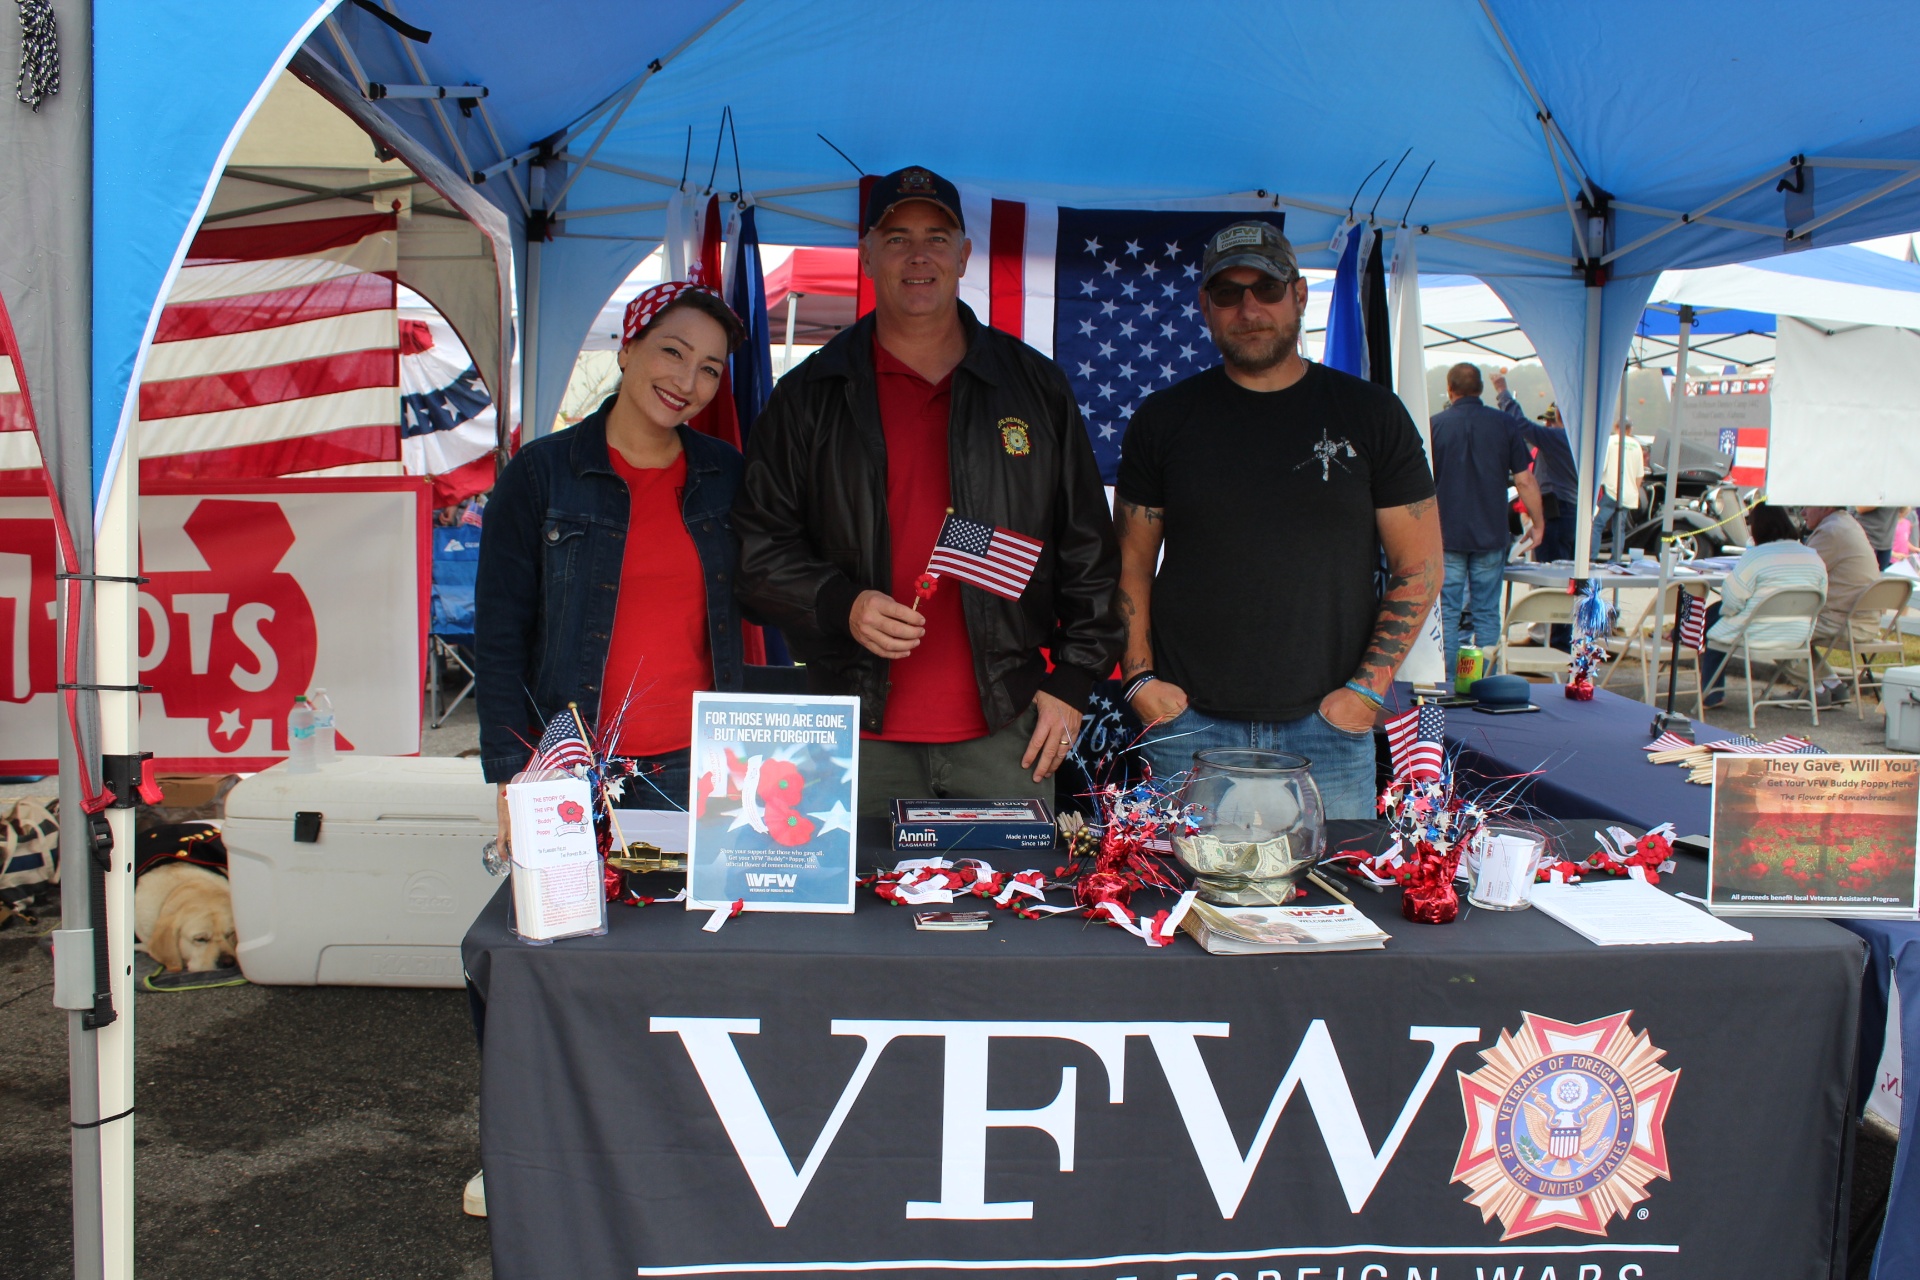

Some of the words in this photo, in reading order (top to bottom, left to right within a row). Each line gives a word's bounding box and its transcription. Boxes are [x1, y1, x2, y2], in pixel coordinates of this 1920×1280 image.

[705, 711, 727, 725] FOR
[728, 711, 763, 726] THOSE
[764, 713, 791, 727] WHO
[792, 714, 813, 727] ARE
[815, 714, 847, 730] GONE,
[714, 727, 735, 742] BUT
[737, 728, 771, 743] NEVER
[773, 729, 838, 744] FORGOTTEN.
[1764, 759, 1802, 775] They
[1803, 759, 1845, 774] Gave,
[1850, 759, 1879, 772] Will
[1885, 759, 1919, 773] You?
[1767, 779, 1783, 788] Get
[1786, 779, 1805, 788] Your
[1807, 780, 1828, 788] VFW
[1831, 779, 1859, 789] Buddy
[1861, 780, 1889, 790] Poppy
[1891, 780, 1914, 788] Here
[1797, 793, 1825, 801] Flower
[1826, 793, 1836, 801] of
[1838, 794, 1896, 802] Remembrance
[899, 828, 938, 842] Annin
[747, 848, 767, 856] support
[746, 873, 798, 888] VFW
[1741, 894, 1770, 902] proceeds
[1872, 895, 1900, 903] Program
[1284, 908, 1345, 916] VFW
[1499, 1065, 1544, 1122] VETERANS
[1548, 1056, 1565, 1071] OF
[1571, 1055, 1618, 1085] FOREIGN
[1614, 1083, 1633, 1121] WARS
[650, 1016, 1480, 1228] VFW
[1499, 1143, 1514, 1160] OF
[1510, 1163, 1532, 1186] THE
[1538, 1180, 1584, 1195] UNITED
[1594, 1139, 1627, 1182] STATES
